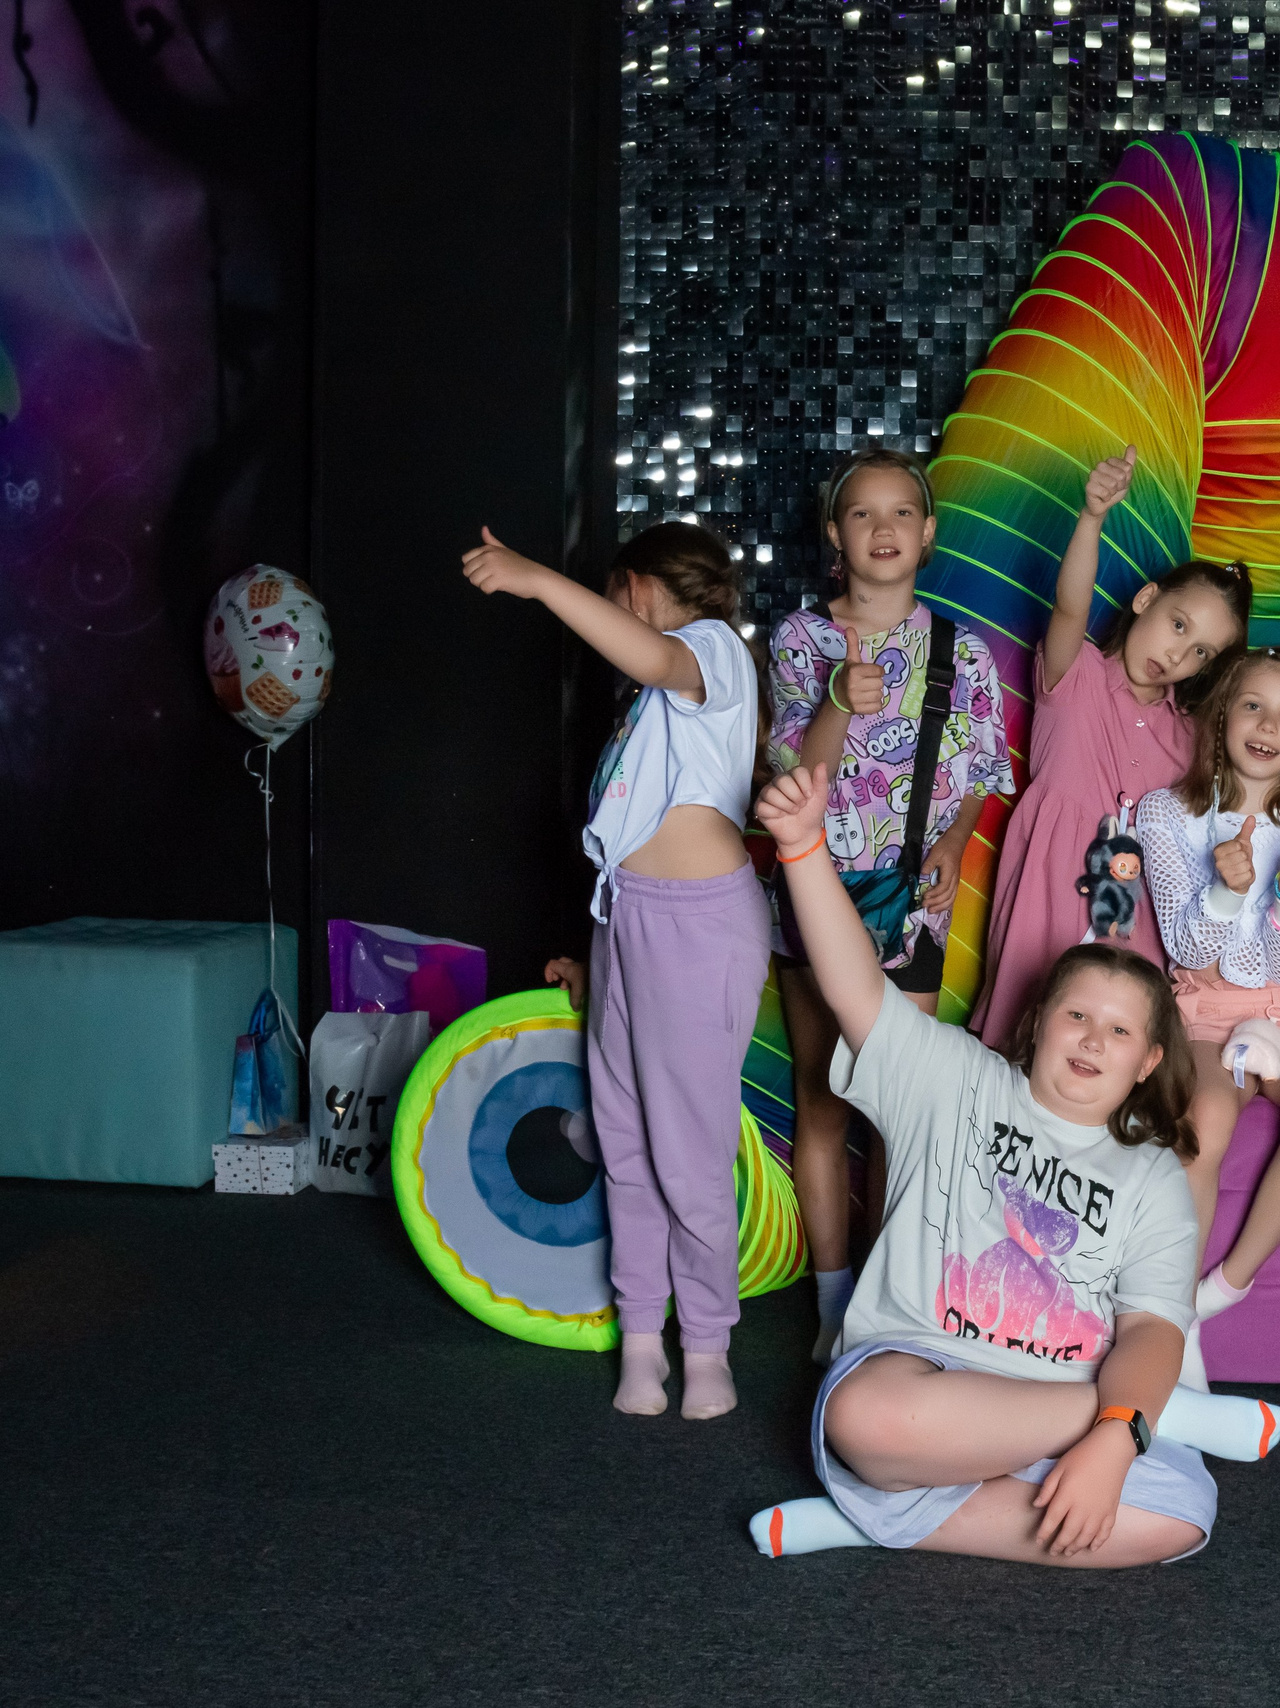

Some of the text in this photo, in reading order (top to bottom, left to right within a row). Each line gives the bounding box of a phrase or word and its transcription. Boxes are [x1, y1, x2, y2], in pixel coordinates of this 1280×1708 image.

[318, 1136, 391, 1178] НЕСУ
[986, 1121, 1034, 1176] BE
[1022, 1154, 1115, 1237] NICE
